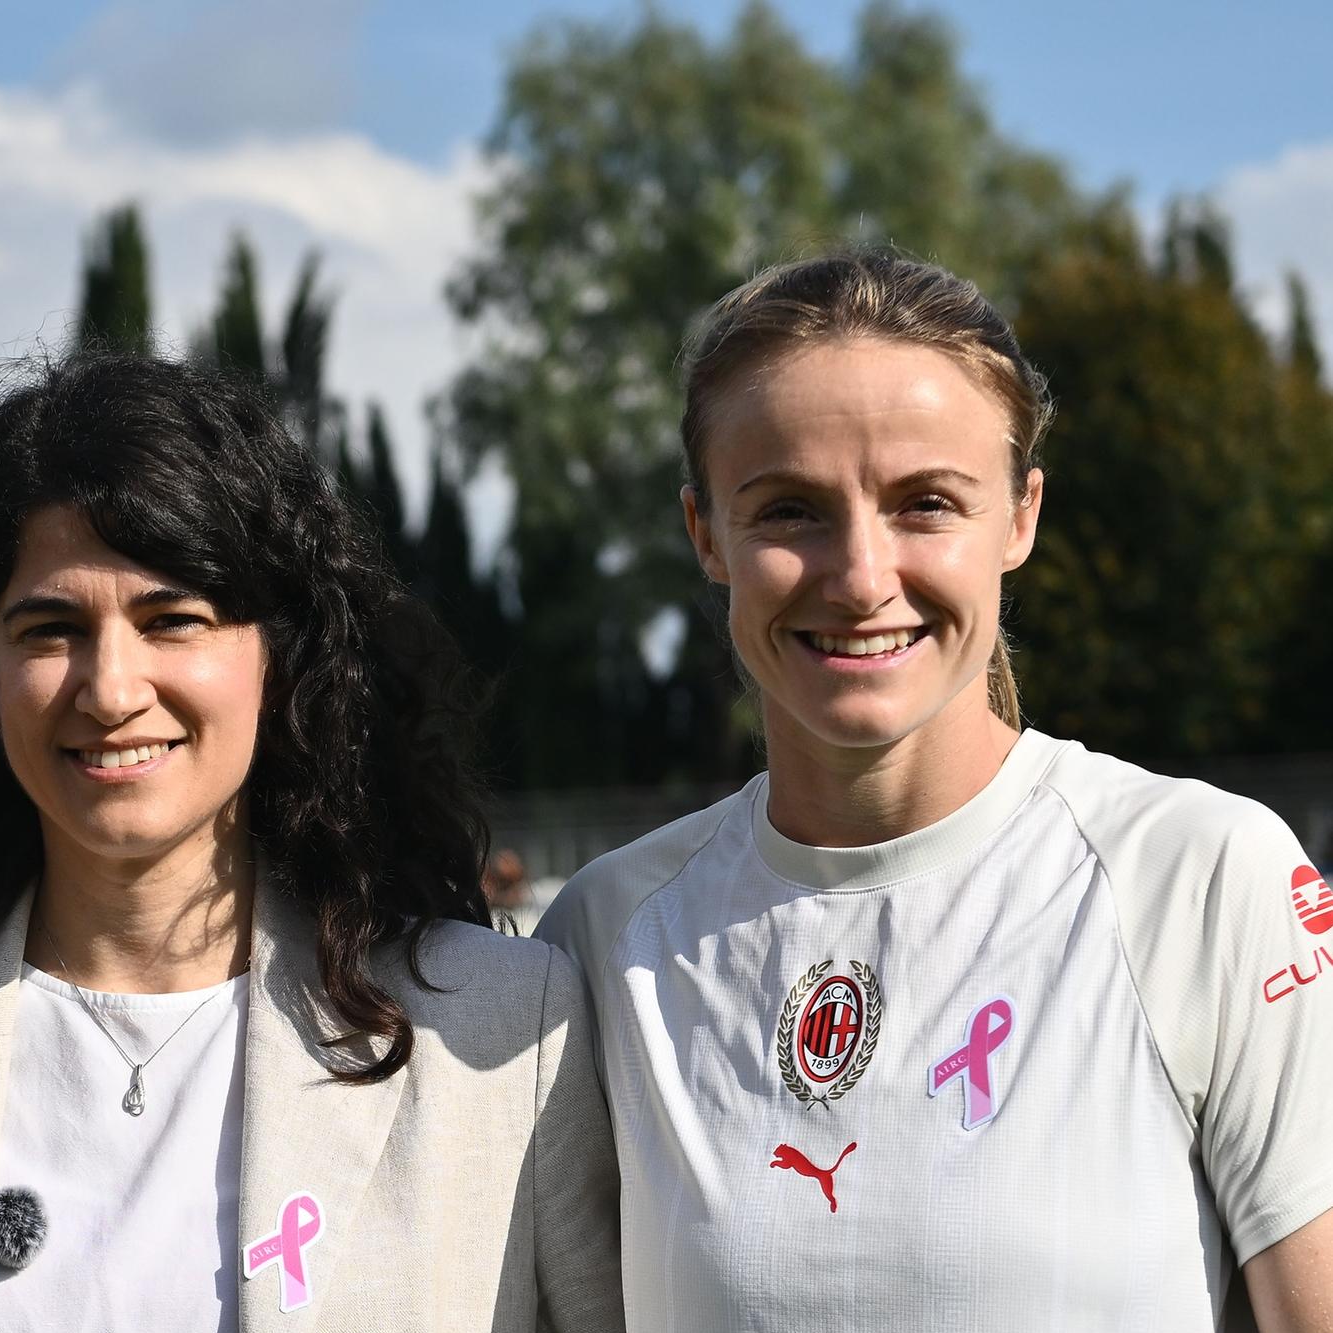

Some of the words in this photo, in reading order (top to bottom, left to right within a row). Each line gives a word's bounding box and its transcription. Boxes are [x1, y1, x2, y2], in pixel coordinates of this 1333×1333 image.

[820, 985, 853, 1004] ACM
[811, 1058, 840, 1070] 1899
[937, 1054, 967, 1078] AIRC
[251, 1242, 279, 1262] AIRC
